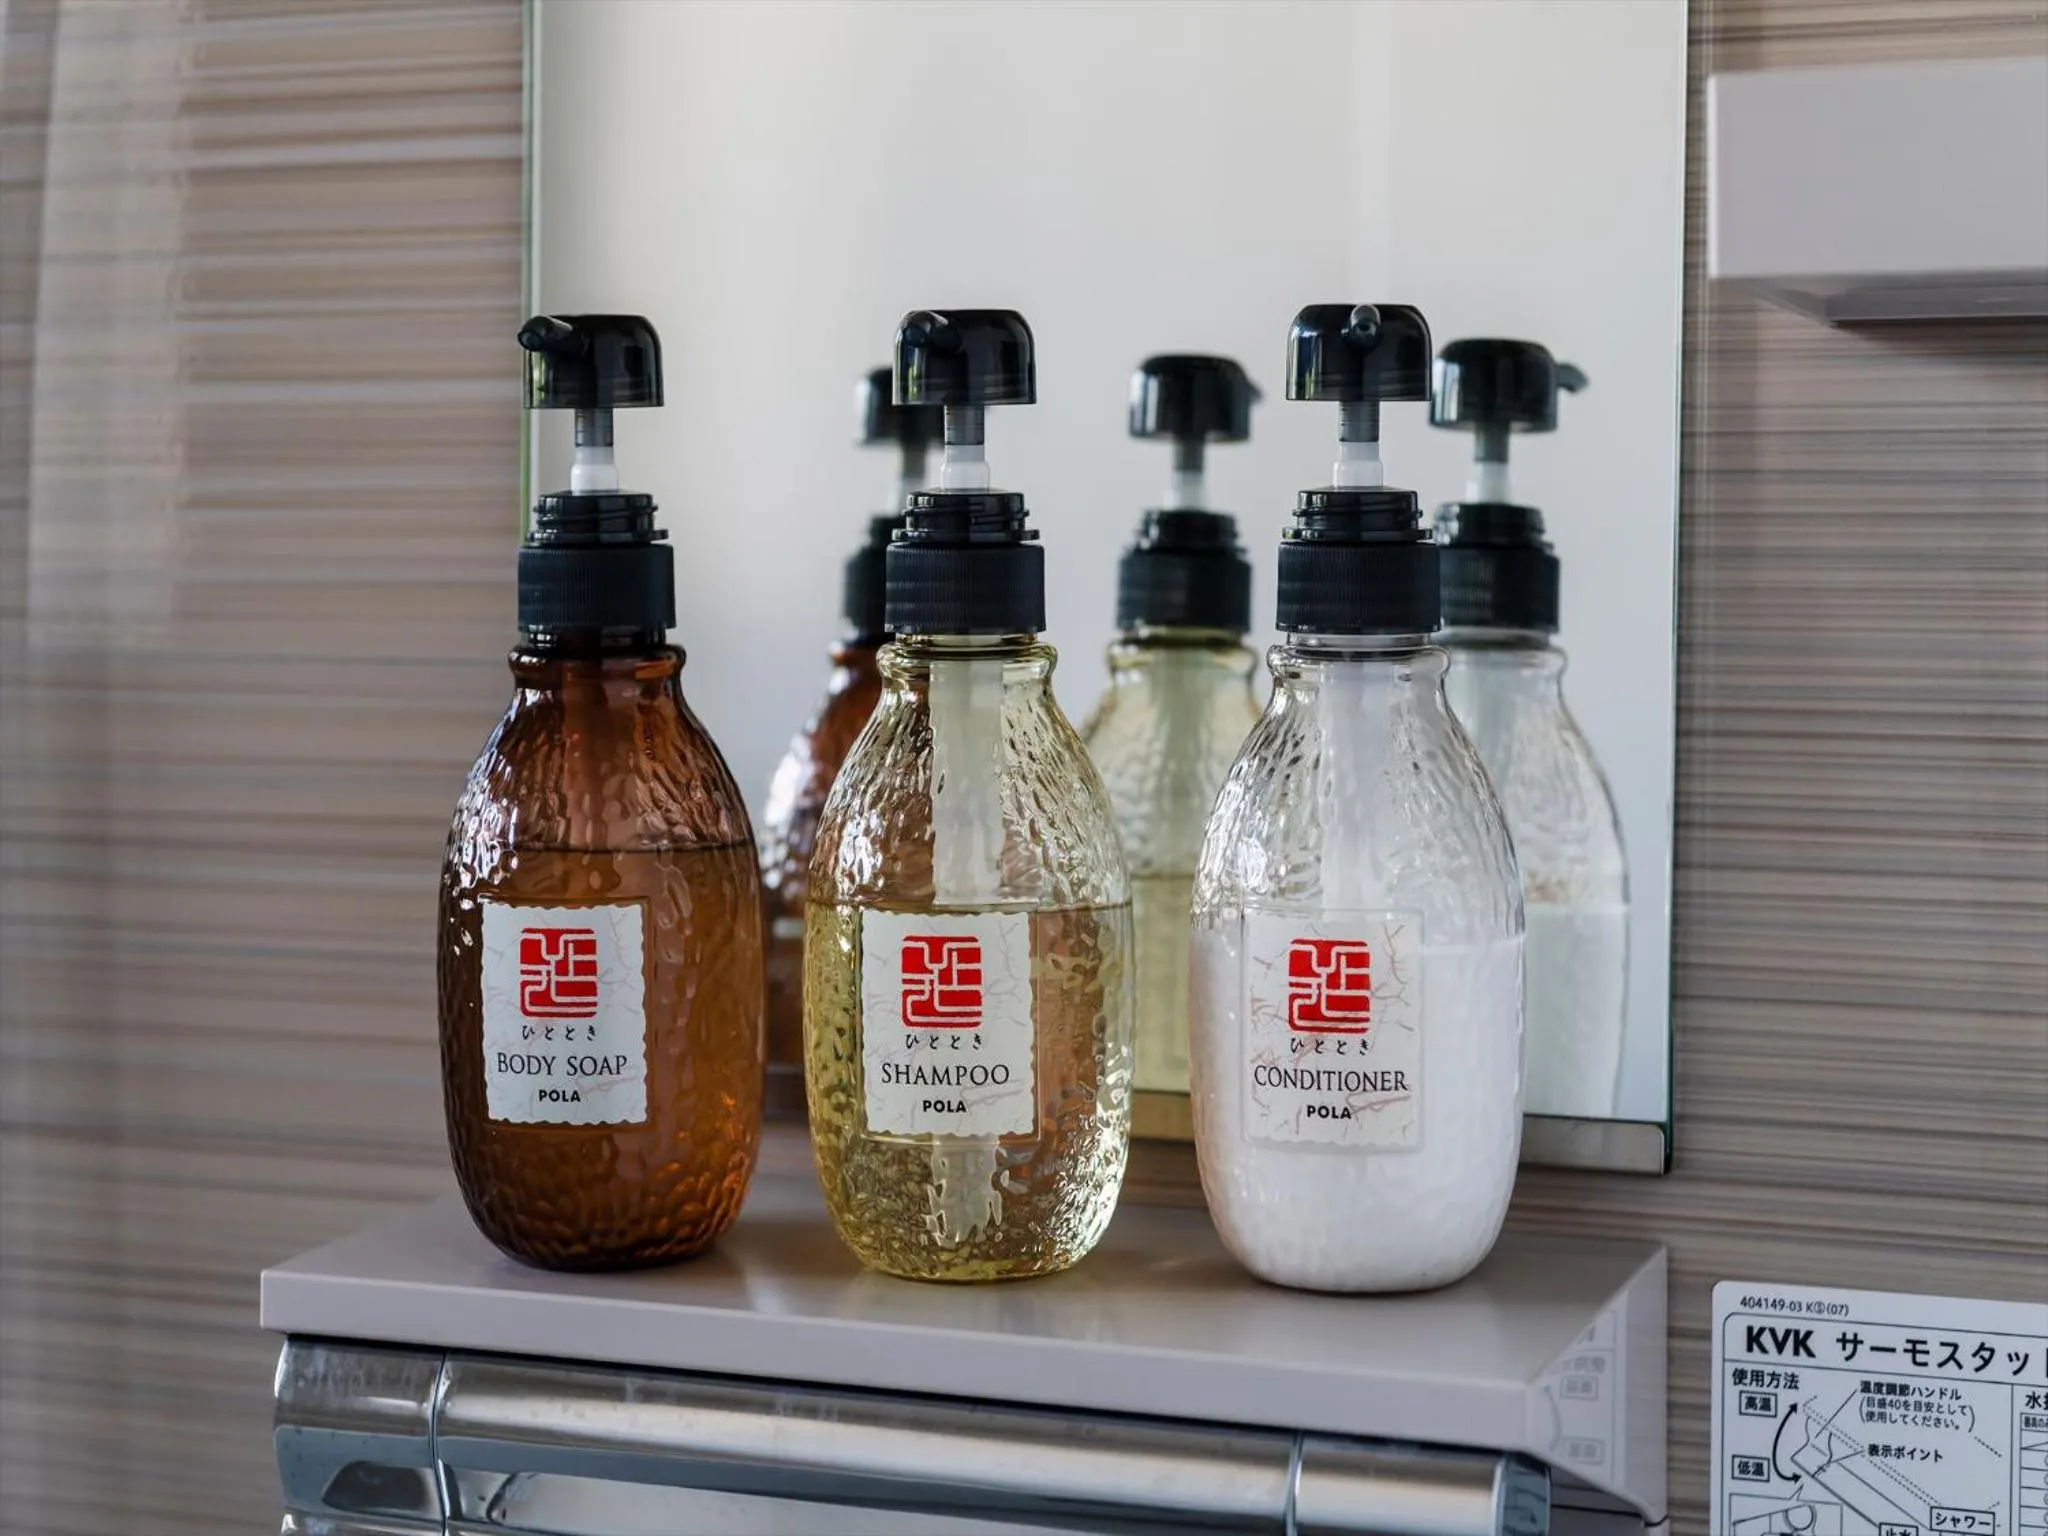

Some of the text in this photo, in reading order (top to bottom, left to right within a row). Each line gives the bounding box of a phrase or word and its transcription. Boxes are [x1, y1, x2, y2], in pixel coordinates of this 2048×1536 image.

[522, 1025, 596, 1041] ひととき
[905, 1033, 982, 1050] ひととき
[1290, 1037, 1369, 1055] ひととき
[497, 1052, 627, 1076] BODY SOAP
[881, 1063, 1009, 1086] SHAMPOO
[1254, 1065, 1408, 1092] CONDITIONER
[538, 1089, 581, 1102] POLA
[923, 1100, 967, 1113] POLA
[1307, 1105, 1351, 1119] POLA
[1740, 1296, 1802, 1312] 404149-03
[1746, 1325, 2048, 1378] KVK サーモスタッ
[1732, 1368, 1799, 1390] 使用方法
[1860, 1380, 1962, 1400] 温度調節ハンドル
[1868, 1444, 1943, 1462] 表示ポイント
[1935, 1512, 1991, 1529] シャワー
